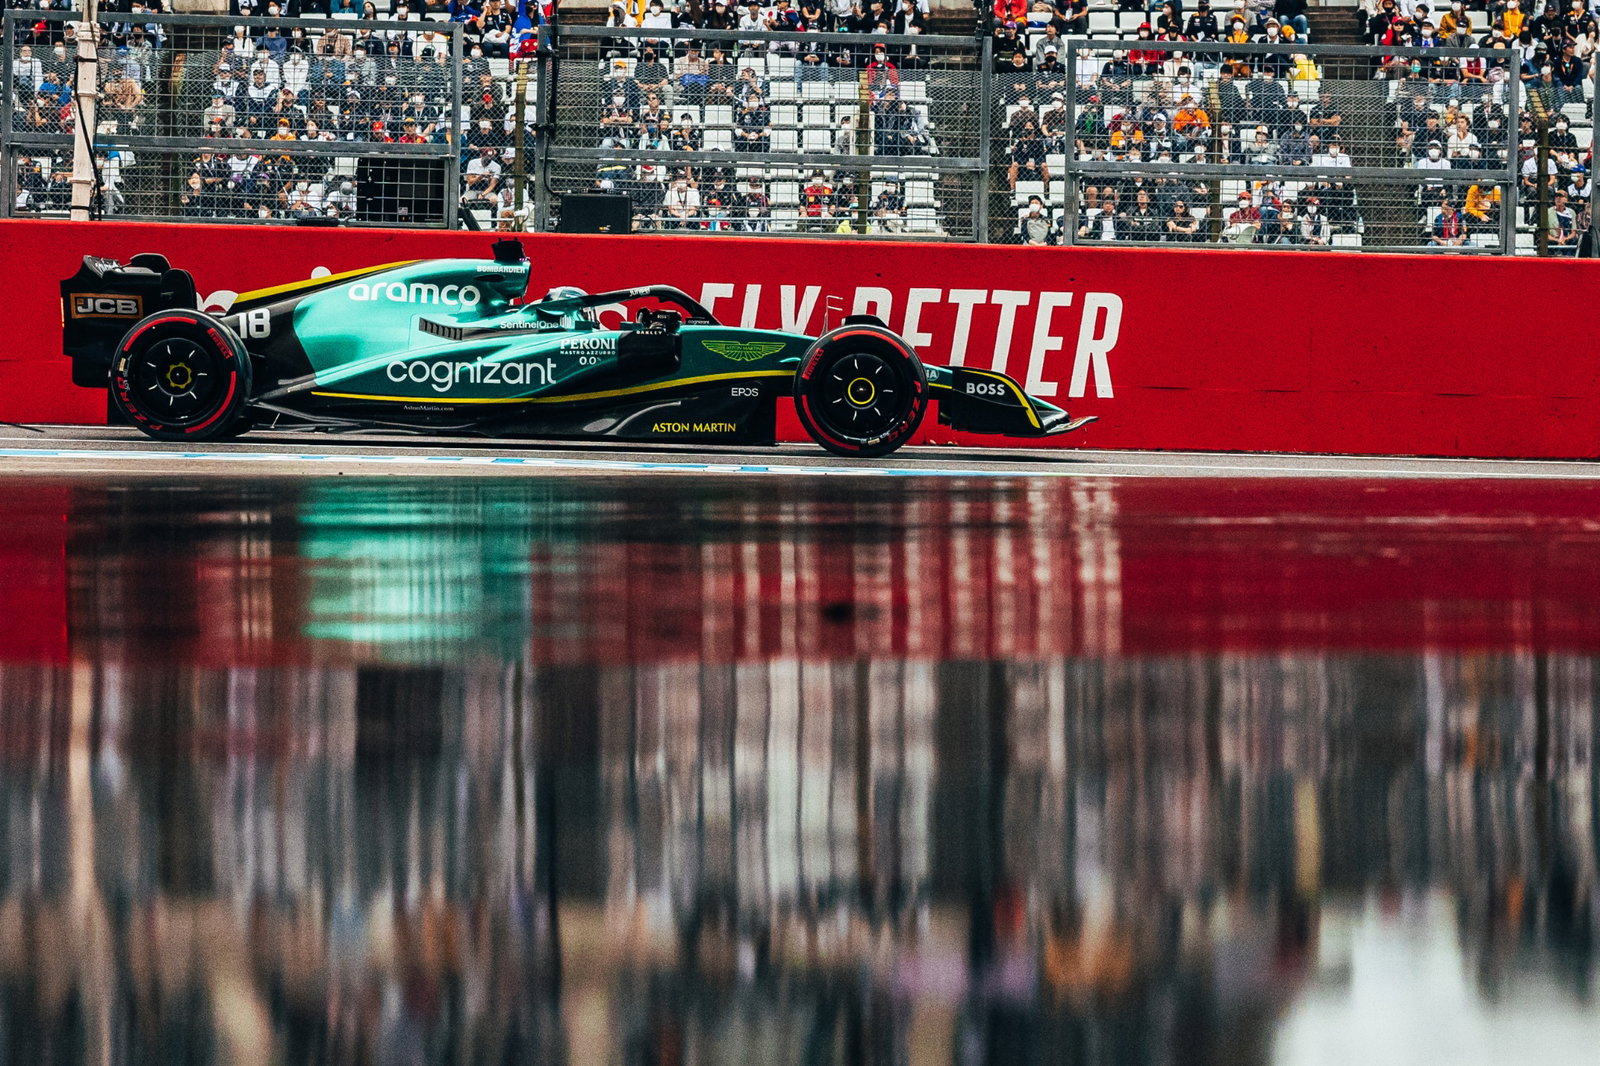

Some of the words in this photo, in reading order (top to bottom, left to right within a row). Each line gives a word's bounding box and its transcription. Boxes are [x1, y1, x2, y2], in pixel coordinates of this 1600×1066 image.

[476, 265, 526, 274] BOMBARDIER
[348, 282, 481, 306] aramco
[77, 298, 138, 314] JCB
[239, 308, 271, 339] 18
[500, 320, 559, 330] SentinelOne
[560, 338, 616, 350] PERONI
[386, 356, 557, 393] cognizant
[731, 387, 759, 397] EPOS
[966, 382, 1005, 396] BOSS
[652, 422, 690, 433] ASTON
[693, 422, 737, 433] MARTIN
